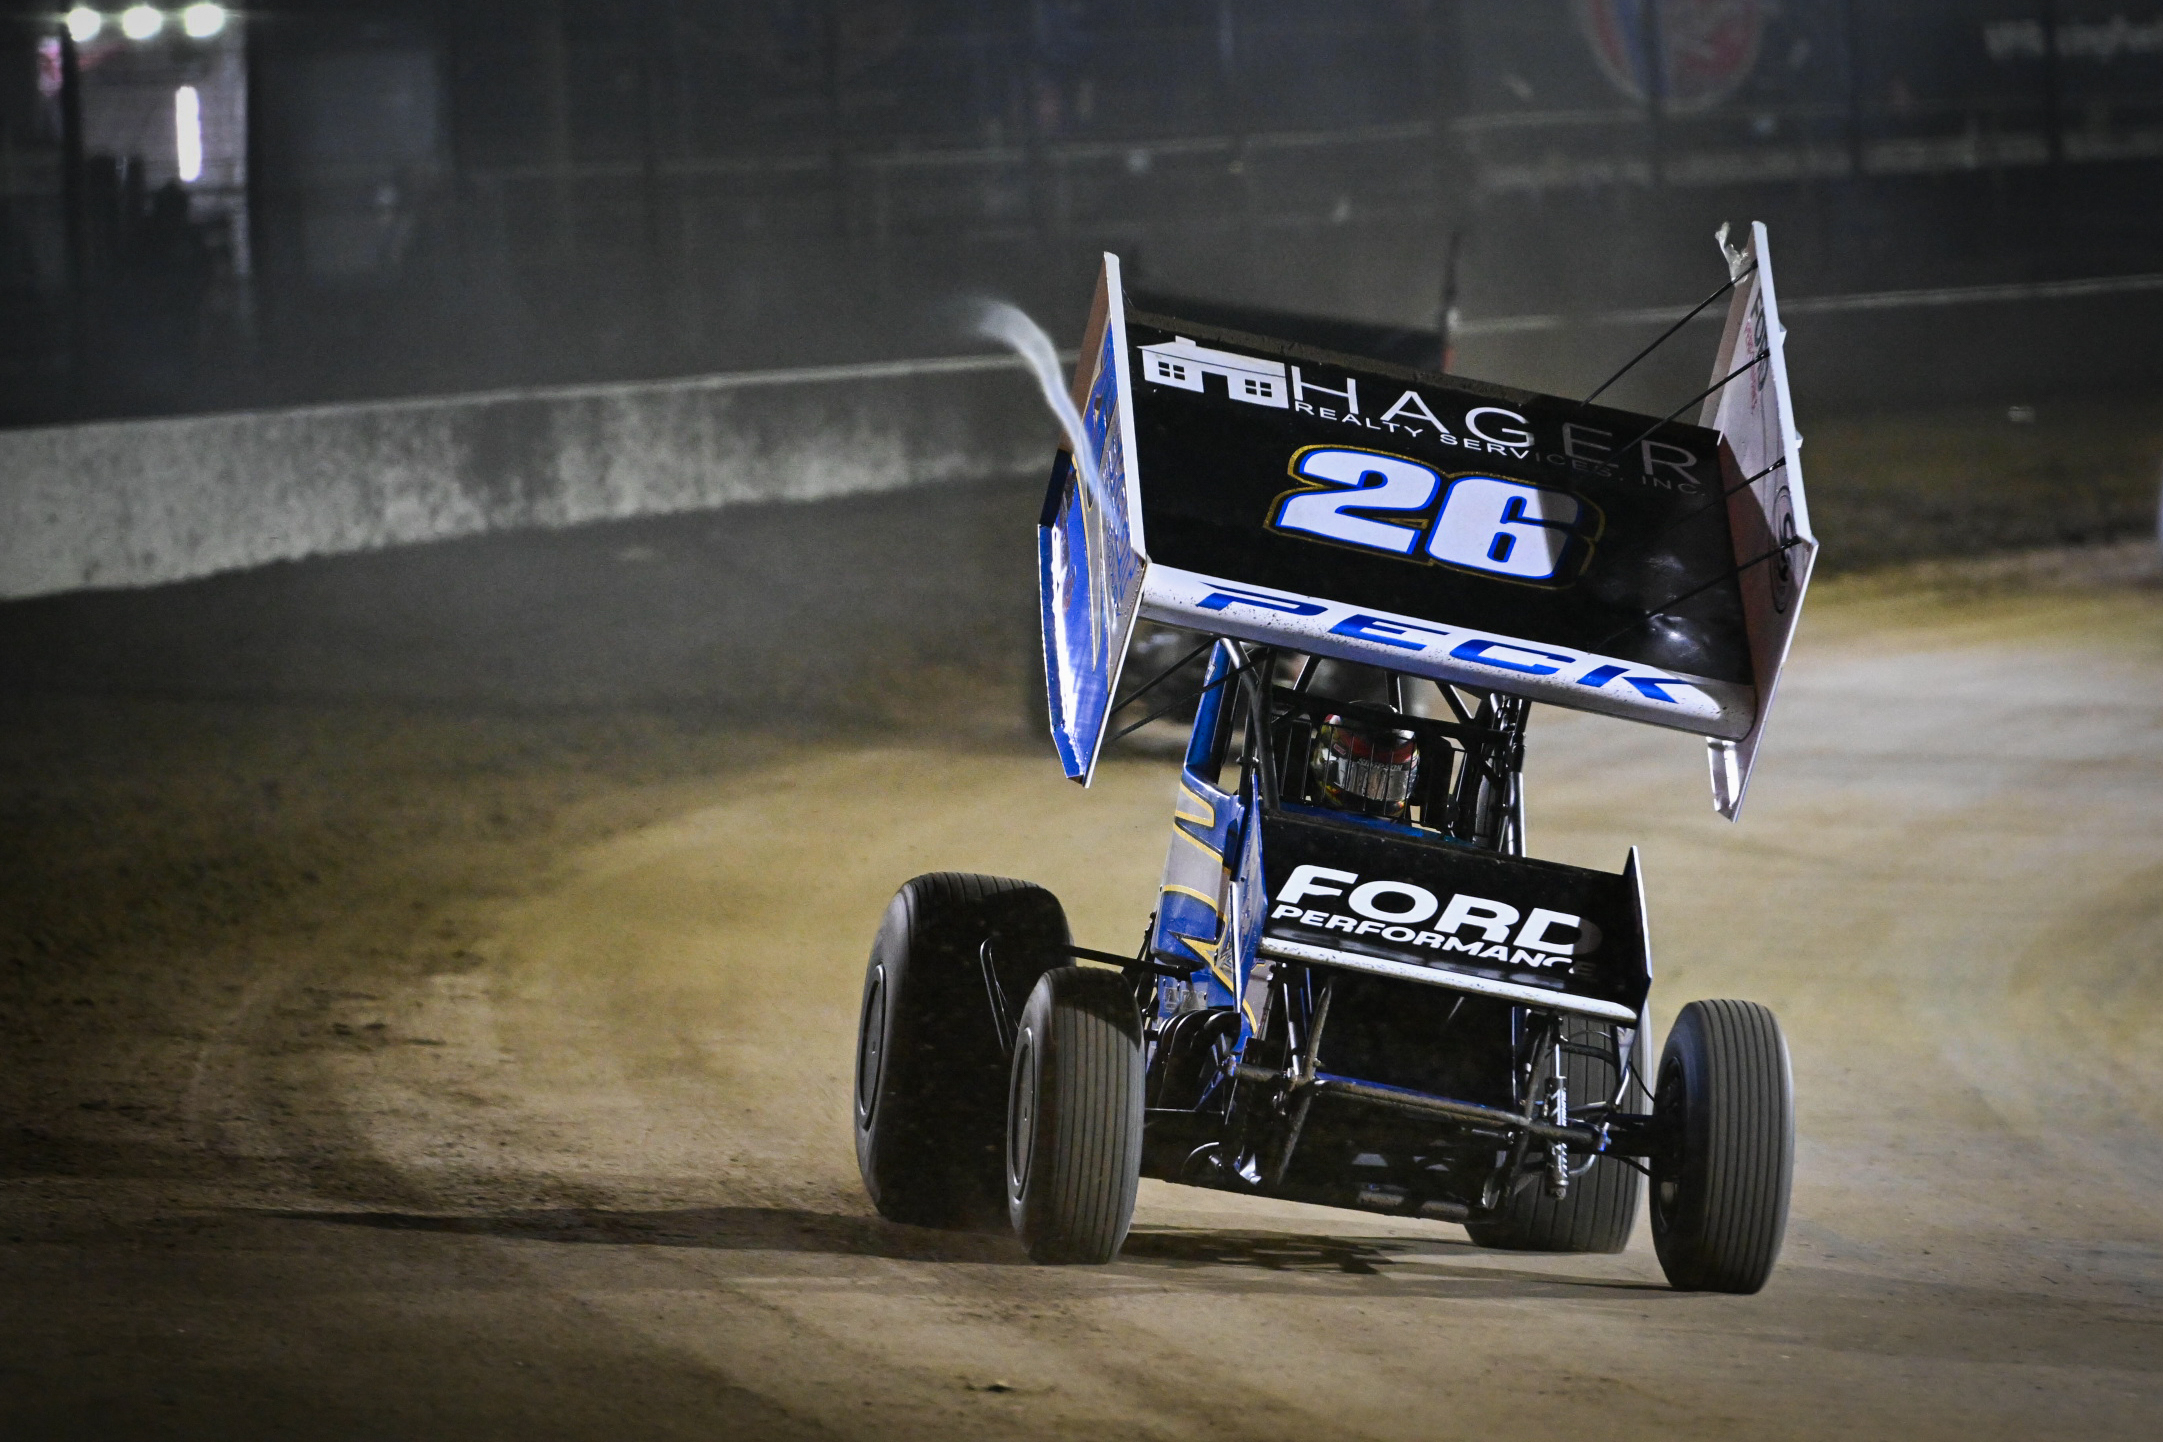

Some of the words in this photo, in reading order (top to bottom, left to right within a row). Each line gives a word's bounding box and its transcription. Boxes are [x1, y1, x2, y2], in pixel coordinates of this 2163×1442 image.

[1291, 365, 1702, 485] HAGER
[1295, 400, 1424, 438] REALTY
[1641, 474, 1706, 496] INC.
[1263, 444, 1606, 591] 26
[1195, 582, 1696, 704] PECK
[1271, 904, 1598, 976] PERFORMANCE
[1276, 864, 1603, 956] FORD
